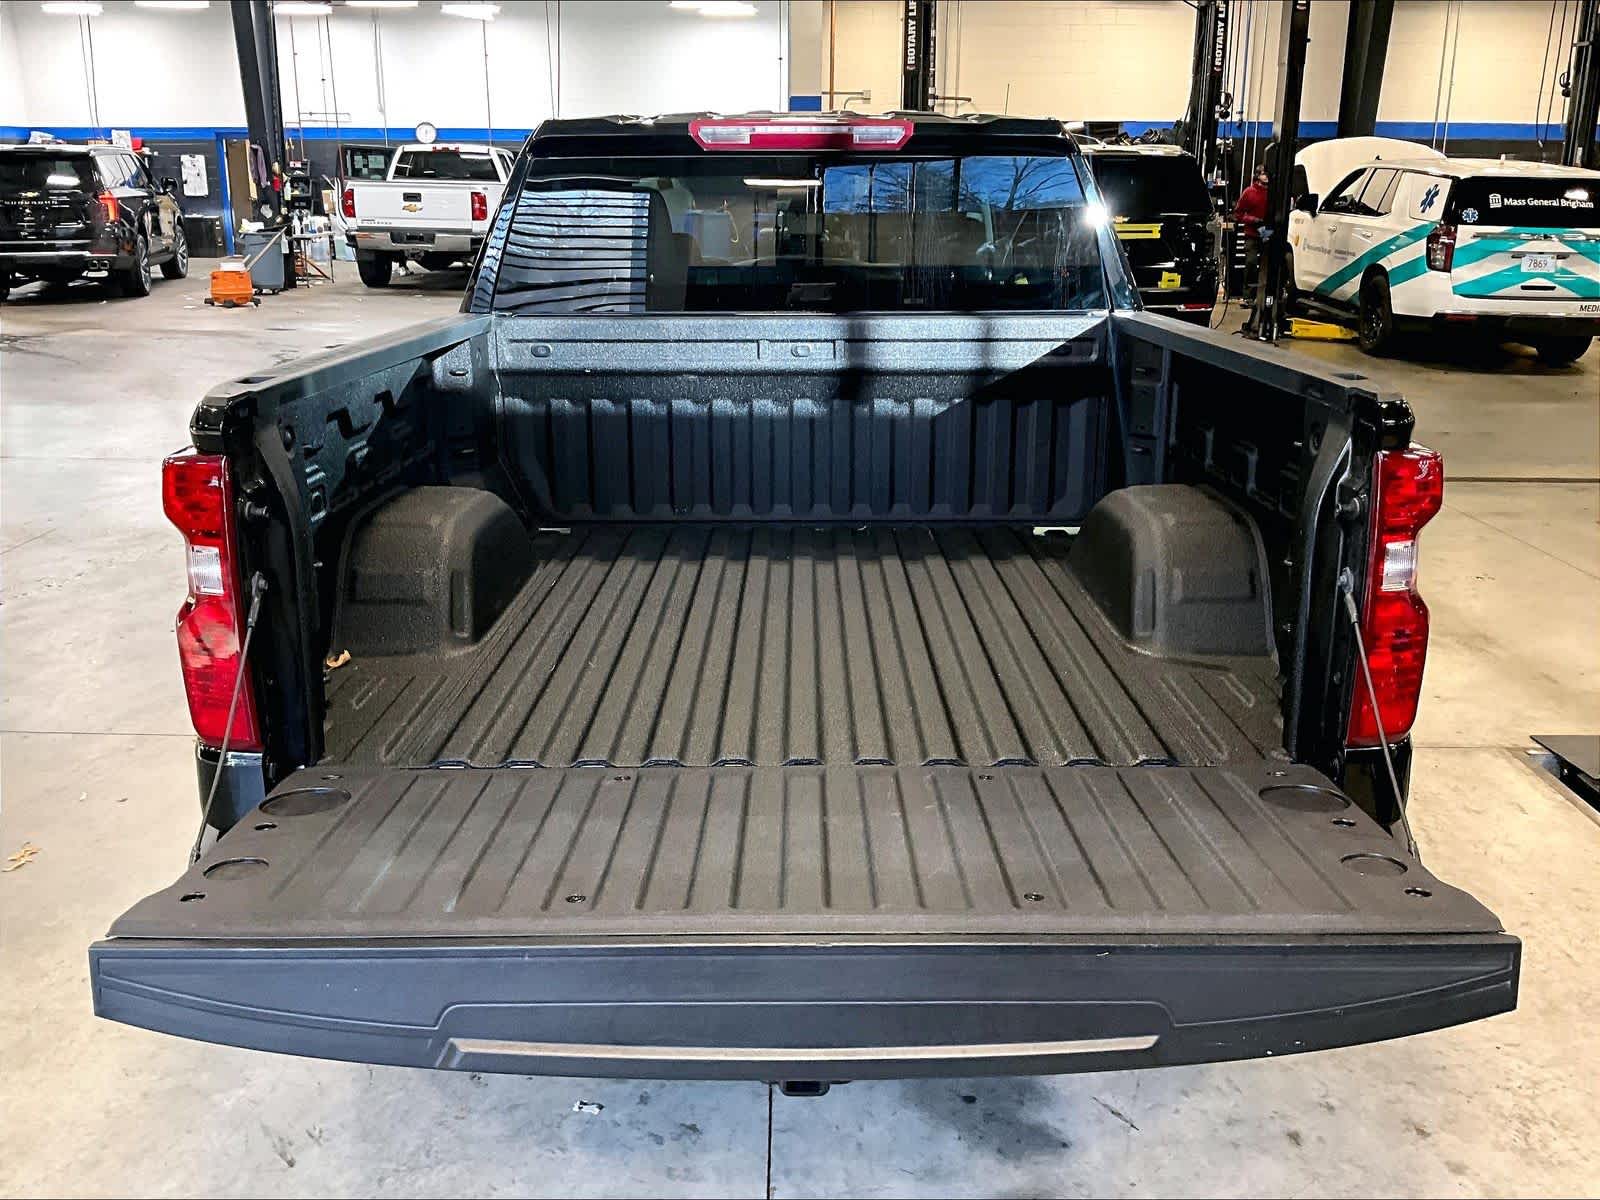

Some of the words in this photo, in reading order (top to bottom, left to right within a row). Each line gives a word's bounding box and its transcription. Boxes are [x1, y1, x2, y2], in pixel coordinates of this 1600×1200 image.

[908, 19, 916, 64] ROTARY
[1215, 21, 1225, 66] ROTARY
[1503, 198, 1526, 206] Mass
[1527, 198, 1559, 206] General
[1560, 198, 1594, 209] Brigham
